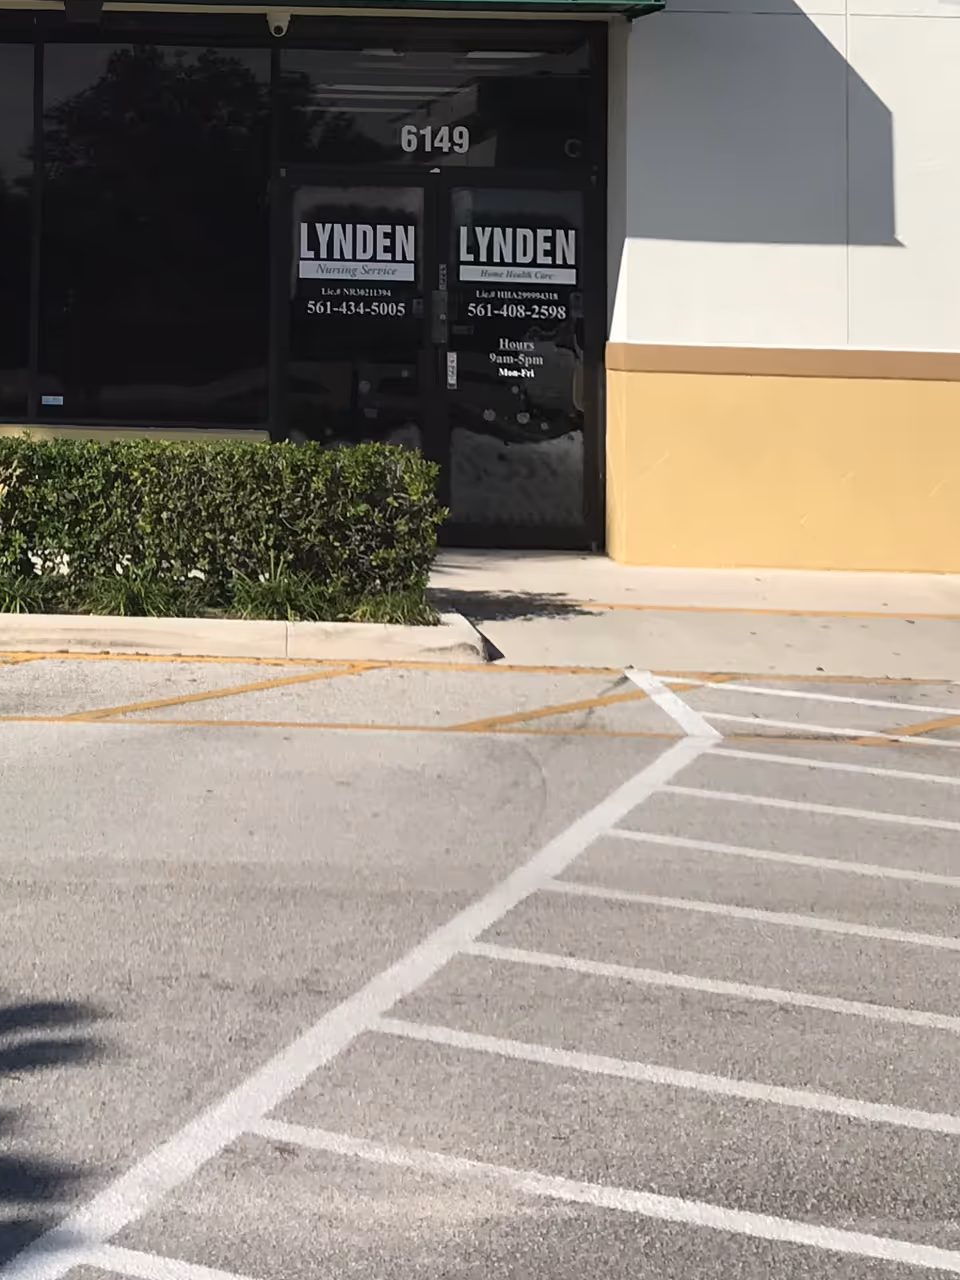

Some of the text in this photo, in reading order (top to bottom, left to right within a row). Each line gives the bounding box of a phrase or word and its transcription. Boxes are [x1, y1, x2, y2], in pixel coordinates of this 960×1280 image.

[400, 125, 470, 153] 6149
[300, 222, 415, 261] LYNDEN
[460, 226, 576, 265] LYNDEN
[316, 263, 398, 278] Nursing Service
[534, 270, 554, 281] Care
[307, 300, 406, 316] 561-434-5005
[467, 303, 567, 320] 561-408-2598
[498, 338, 535, 351] Hours
[489, 352, 544, 367] 9am-5pm
[498, 367, 535, 378] Mon-Fri
